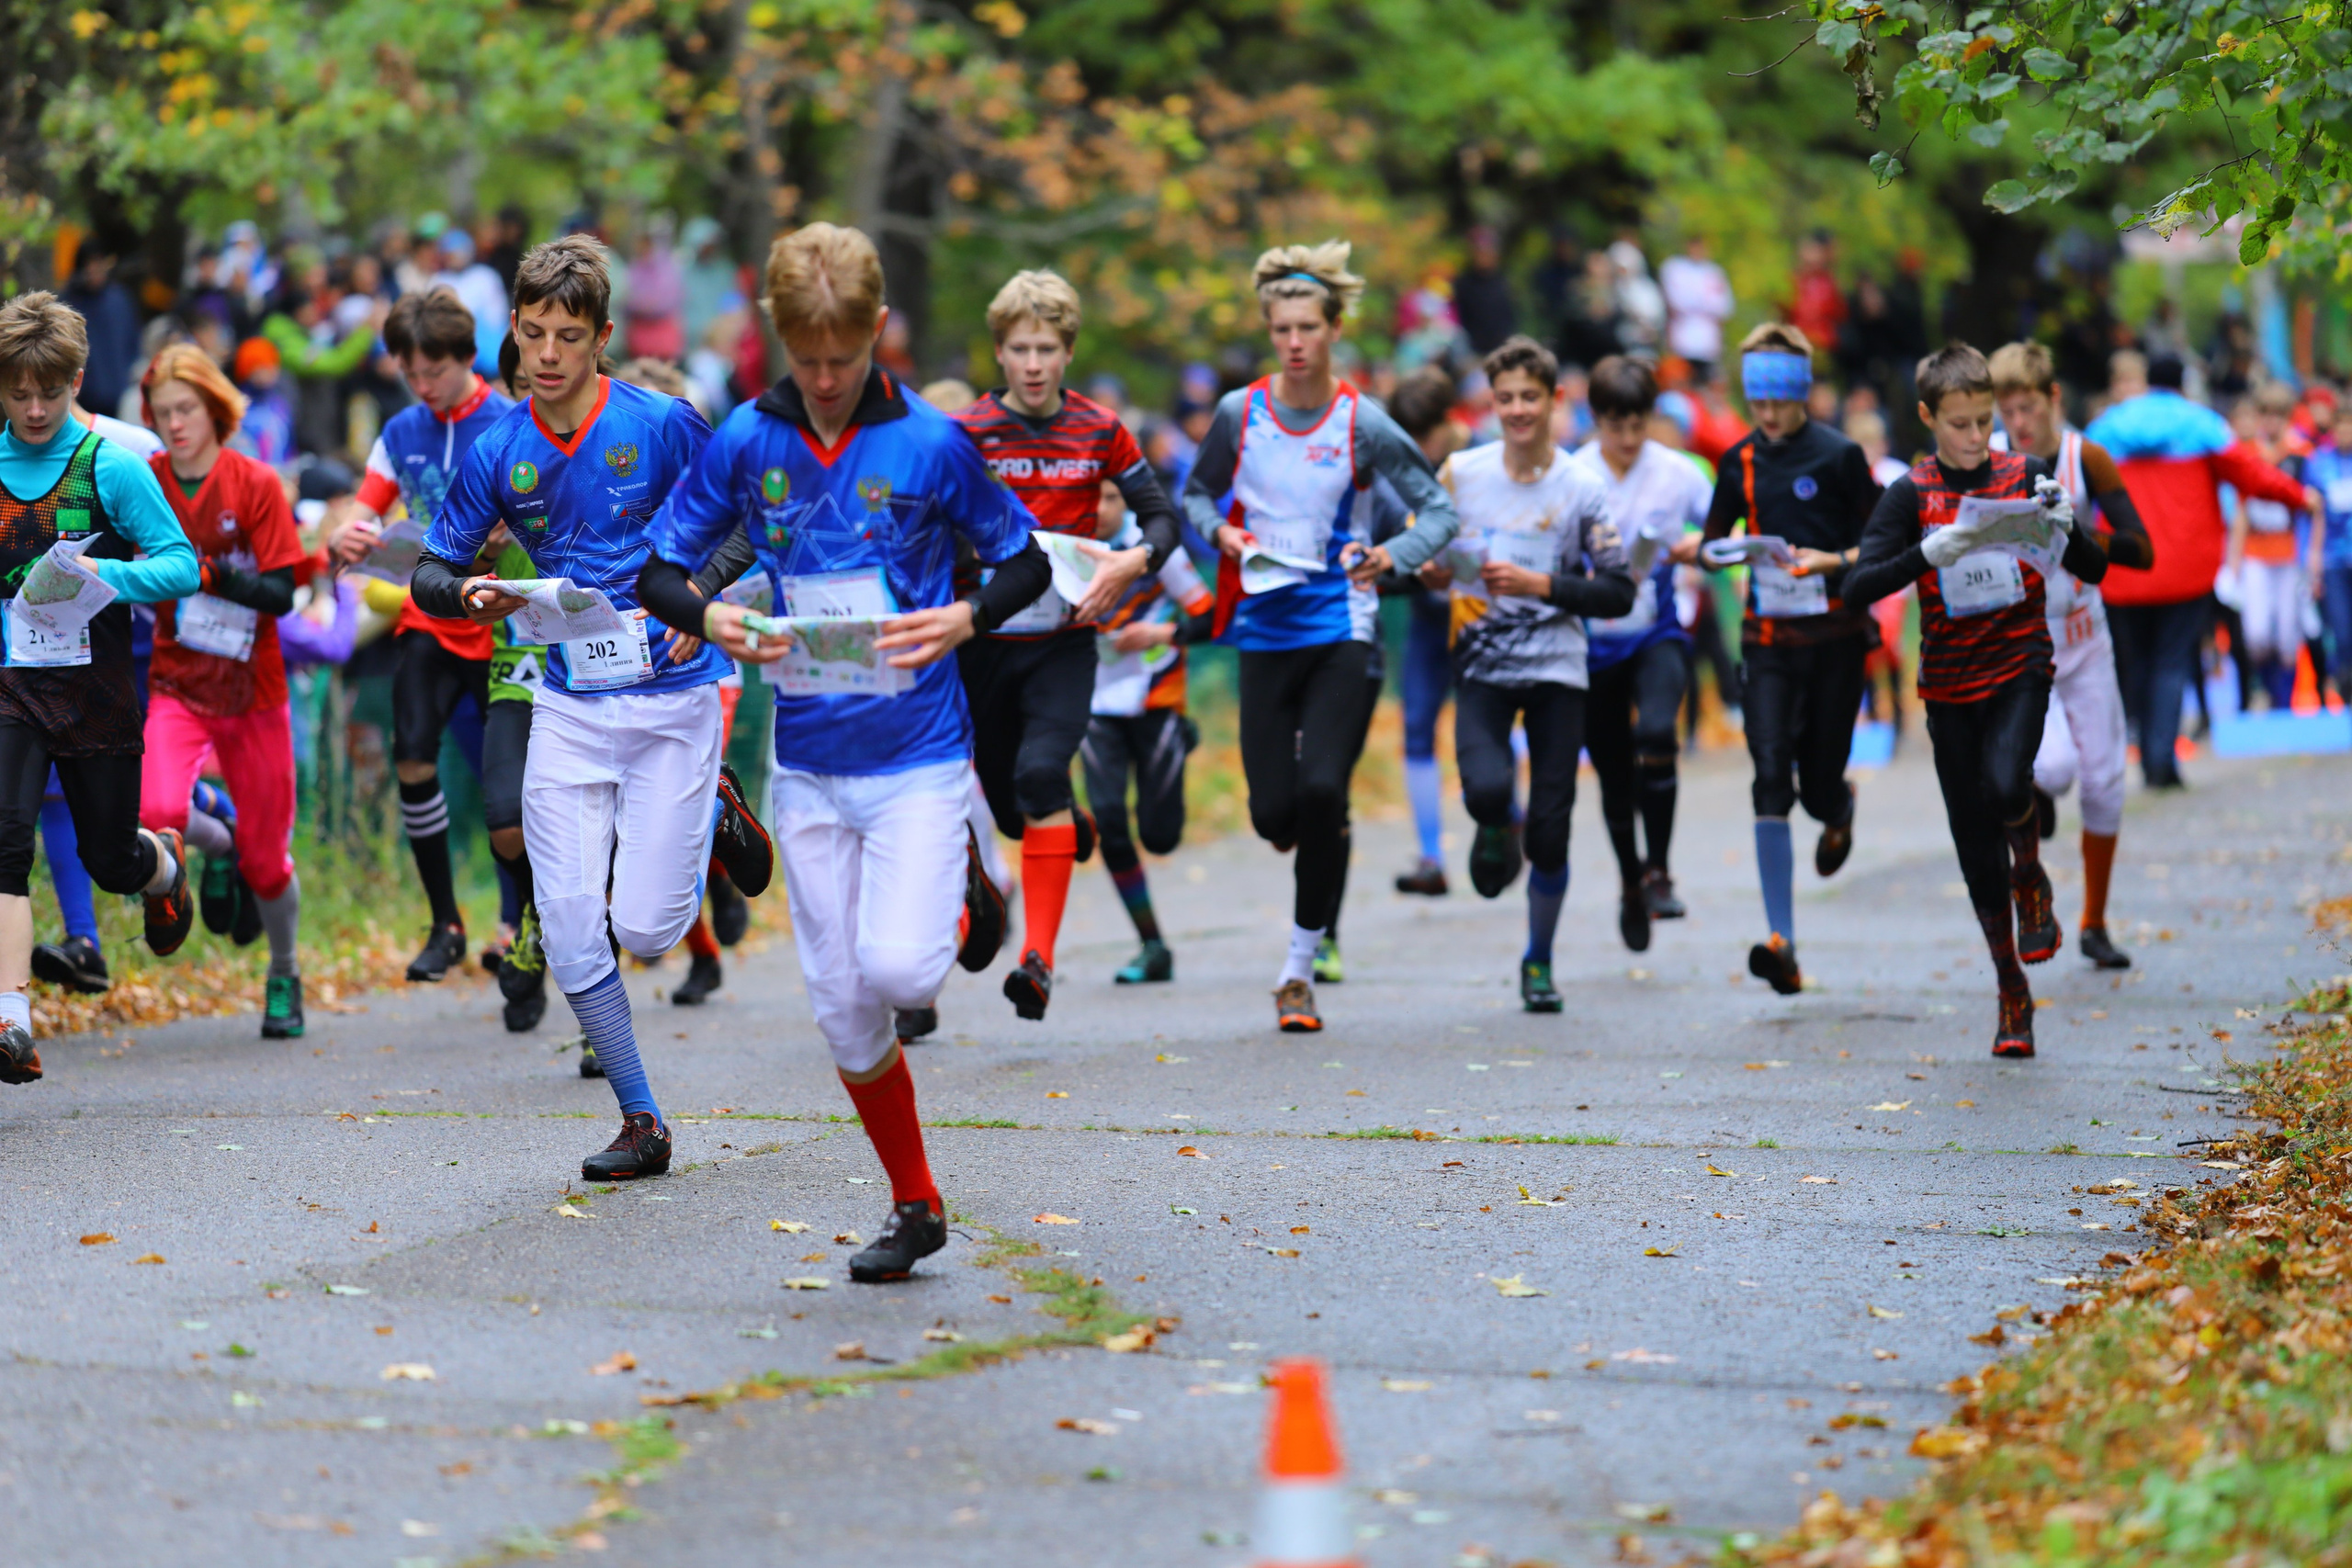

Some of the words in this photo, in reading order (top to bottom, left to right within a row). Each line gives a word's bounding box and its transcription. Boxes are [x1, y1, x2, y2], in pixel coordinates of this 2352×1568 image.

[1037, 457, 1101, 480] WEST
[528, 519, 544, 528] SFR
[1965, 569, 1994, 586] 203
[28, 629, 52, 644] 21
[585, 640, 617, 660] 202
